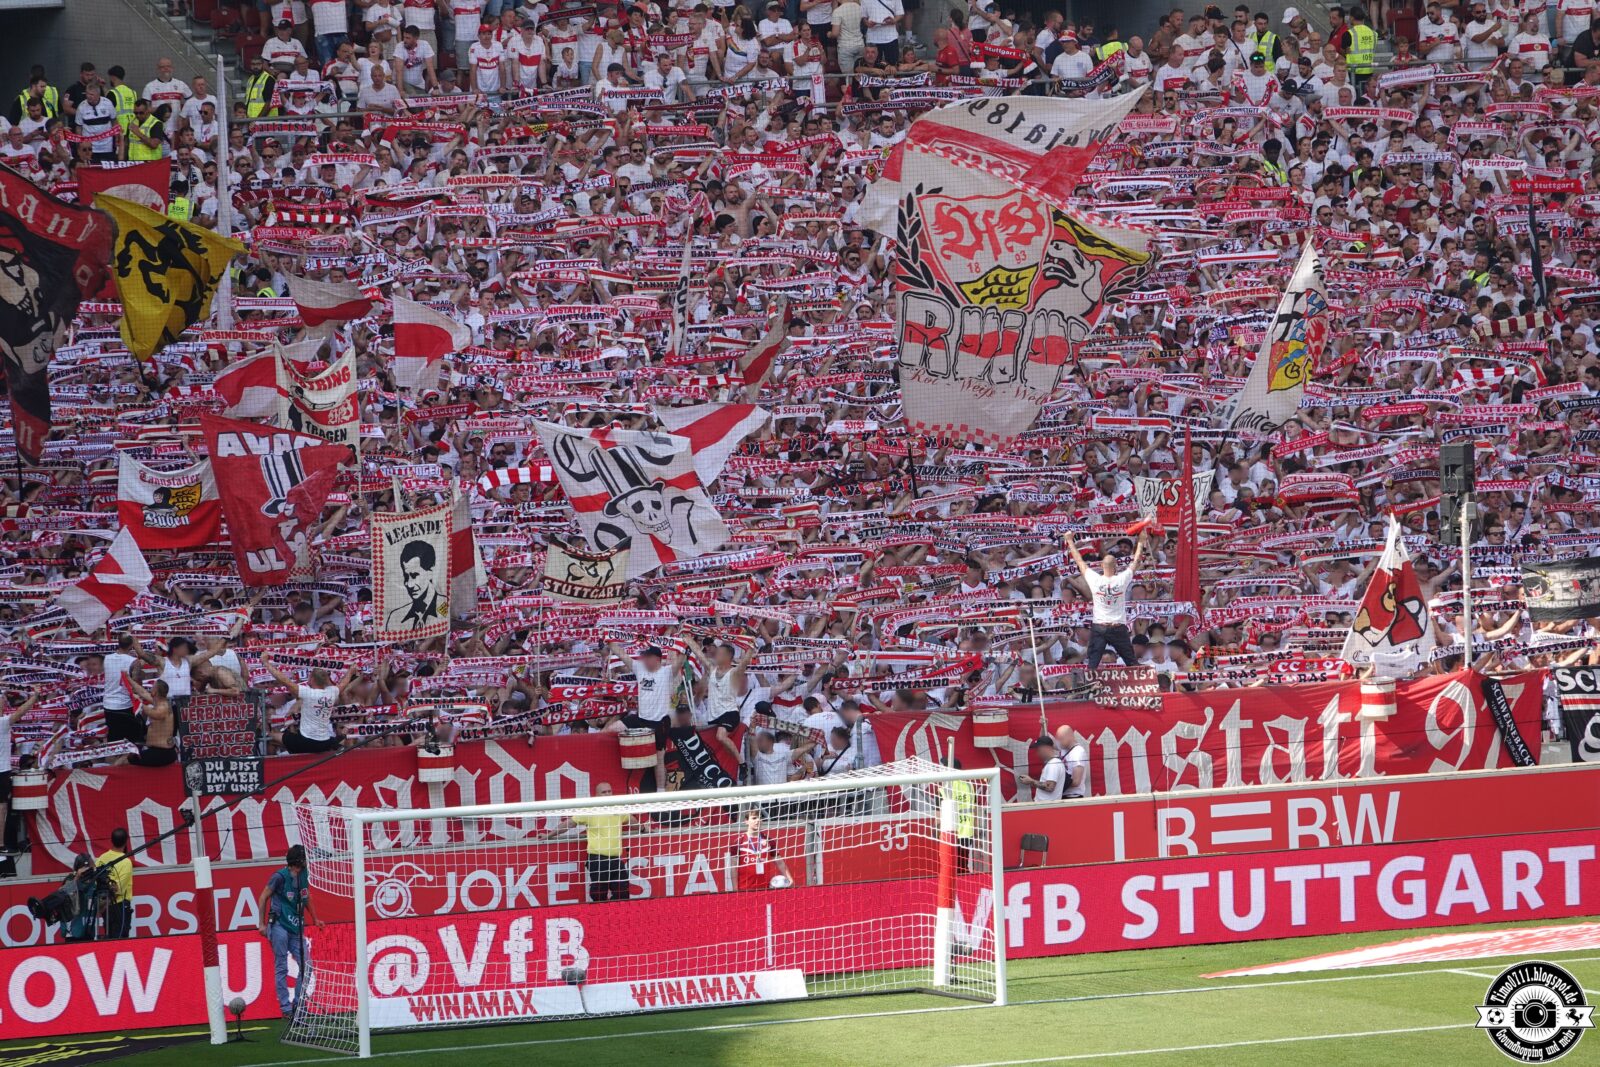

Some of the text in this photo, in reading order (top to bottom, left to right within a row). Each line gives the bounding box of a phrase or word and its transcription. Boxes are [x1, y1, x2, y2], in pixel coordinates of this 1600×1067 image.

[310, 153, 375, 166] STUTTGART
[1484, 159, 1525, 169] Stuttgart
[1533, 182, 1575, 191] Stuttgart
[548, 312, 606, 324] STUTTGART
[783, 405, 824, 414] Stuttgart
[1463, 404, 1535, 415] STUTTGART
[305, 421, 348, 443] TRAGEN
[385, 519, 444, 546] LEGENDE
[679, 550, 757, 572] STUTTGART
[543, 578, 624, 599] STUTTGART
[273, 653, 344, 670] COMMANDO
[562, 686, 589, 698] CC
[871, 677, 950, 692] COMMANDO
[181, 703, 255, 722] VERBANNTE
[768, 717, 812, 738] 1893
[204, 760, 260, 772] DU BIST
[205, 771, 260, 784] IMMER
[206, 784, 227, 793] BEI
[879, 823, 909, 852] 35
[1120, 843, 1597, 941] STUTTGART
[367, 914, 590, 998] @VfB
[631, 974, 763, 1010] WINAMAX
[407, 990, 536, 1024] WINAMAX
